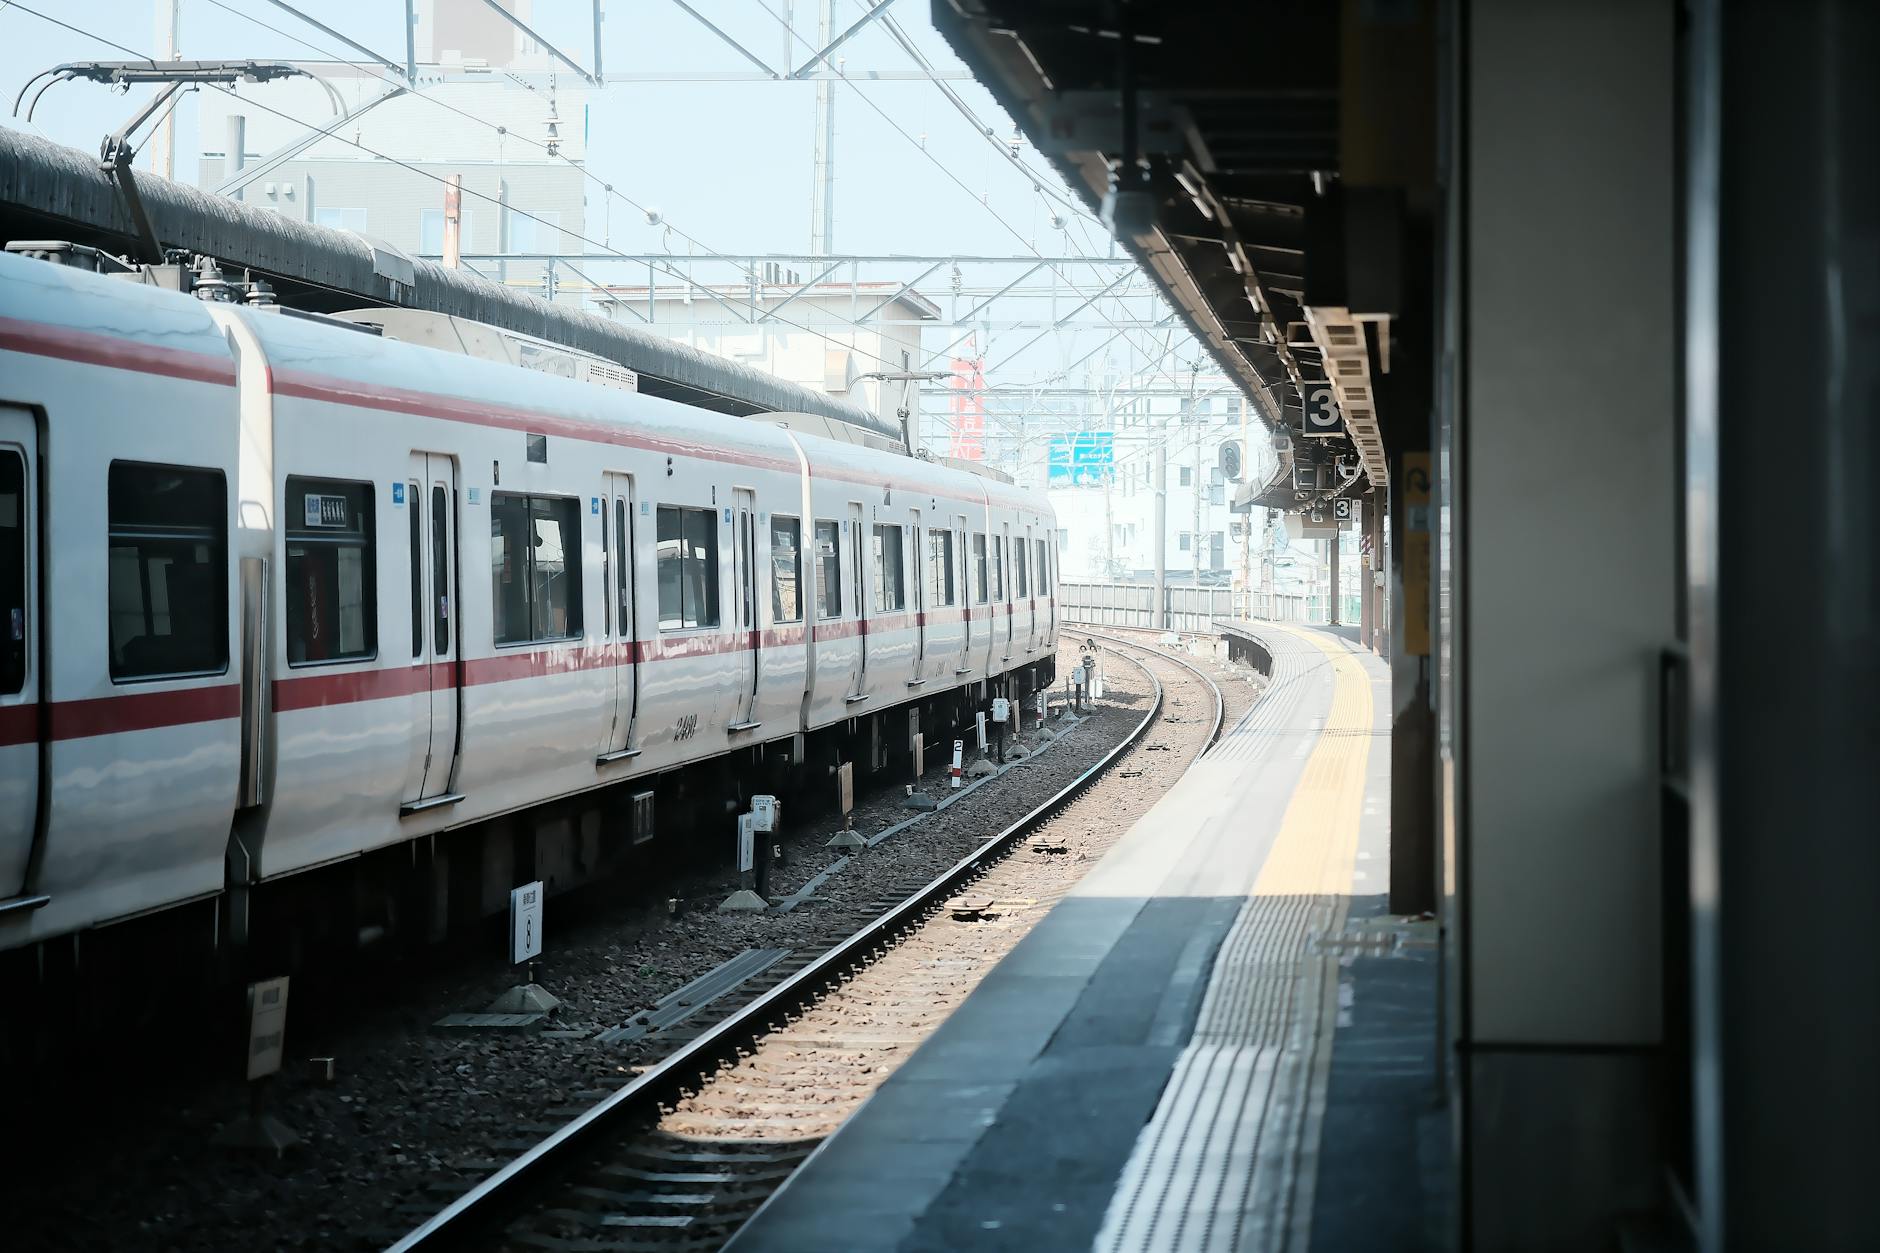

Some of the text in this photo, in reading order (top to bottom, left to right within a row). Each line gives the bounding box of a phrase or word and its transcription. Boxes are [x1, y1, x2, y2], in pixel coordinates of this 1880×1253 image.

[1310, 389, 1339, 426] 3
[1336, 501, 1349, 516] 3
[955, 741, 962, 751] 2
